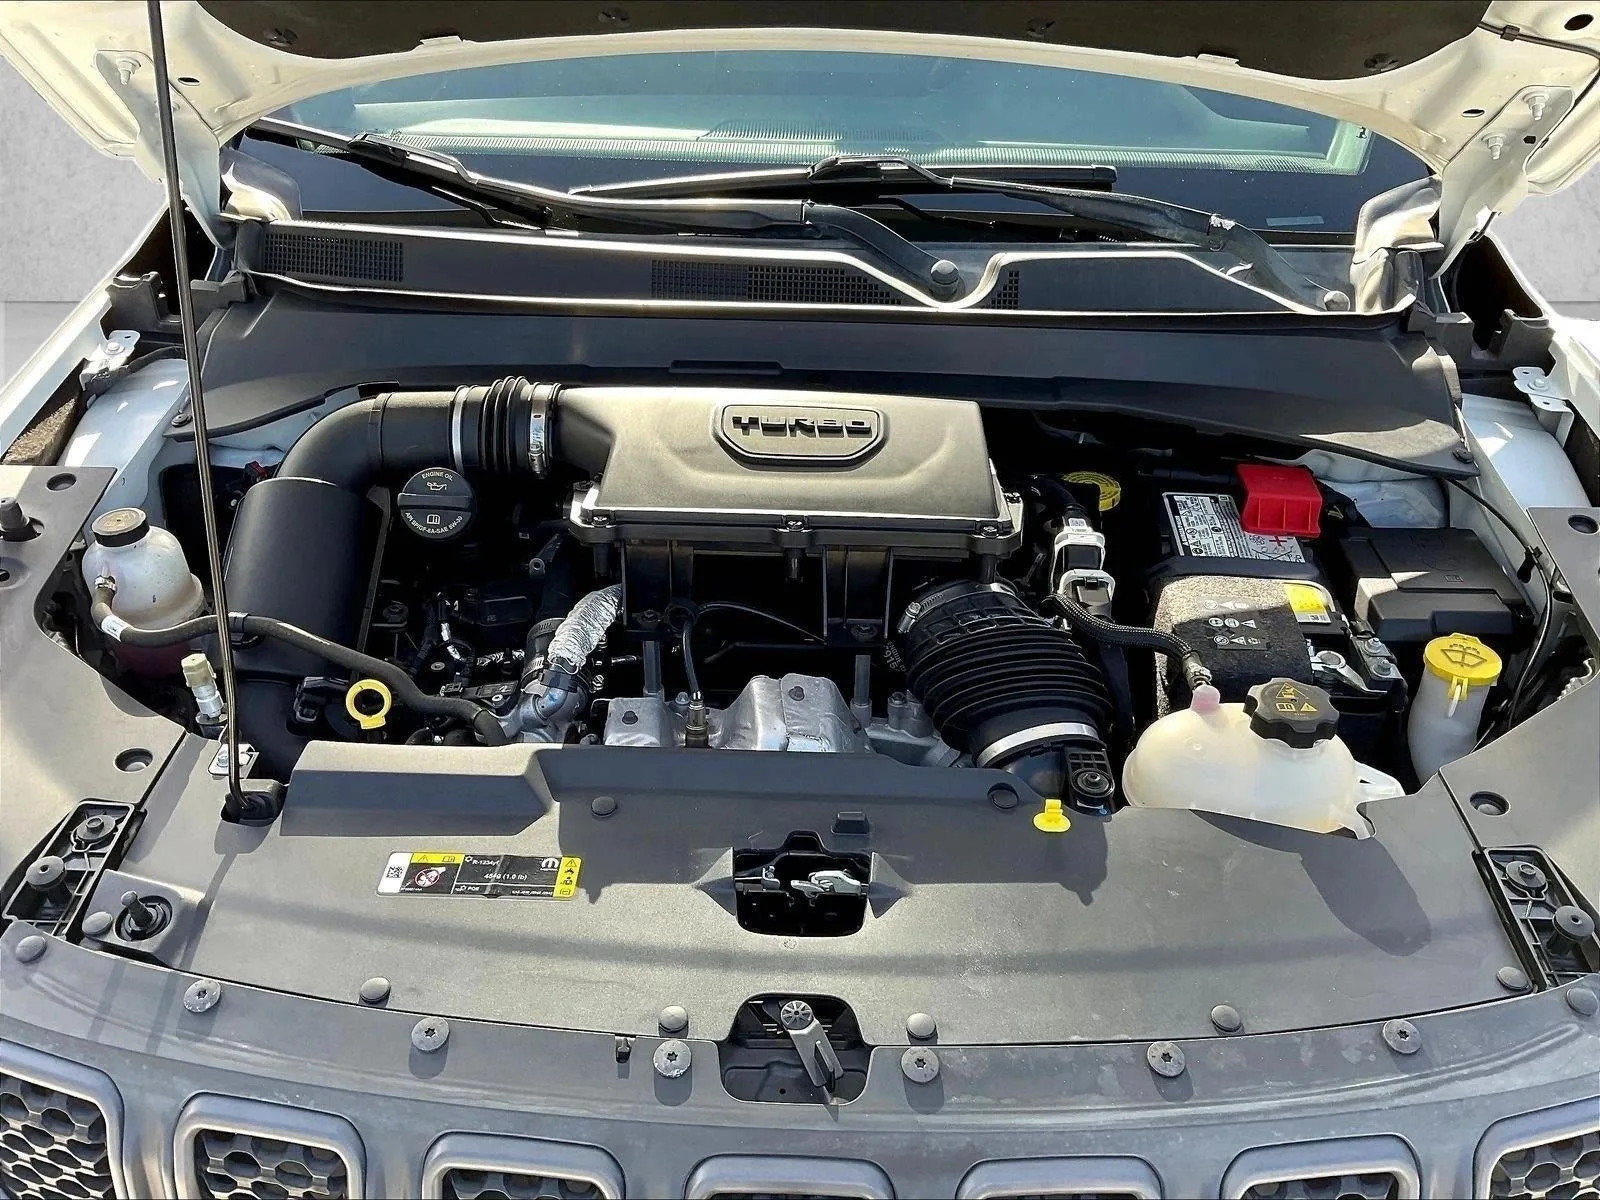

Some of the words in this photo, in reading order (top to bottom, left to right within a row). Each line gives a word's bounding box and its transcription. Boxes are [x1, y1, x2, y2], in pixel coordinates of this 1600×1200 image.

[732, 416, 872, 438] TURBO
[421, 471, 443, 479] ENGINE
[445, 473, 453, 481] OIL
